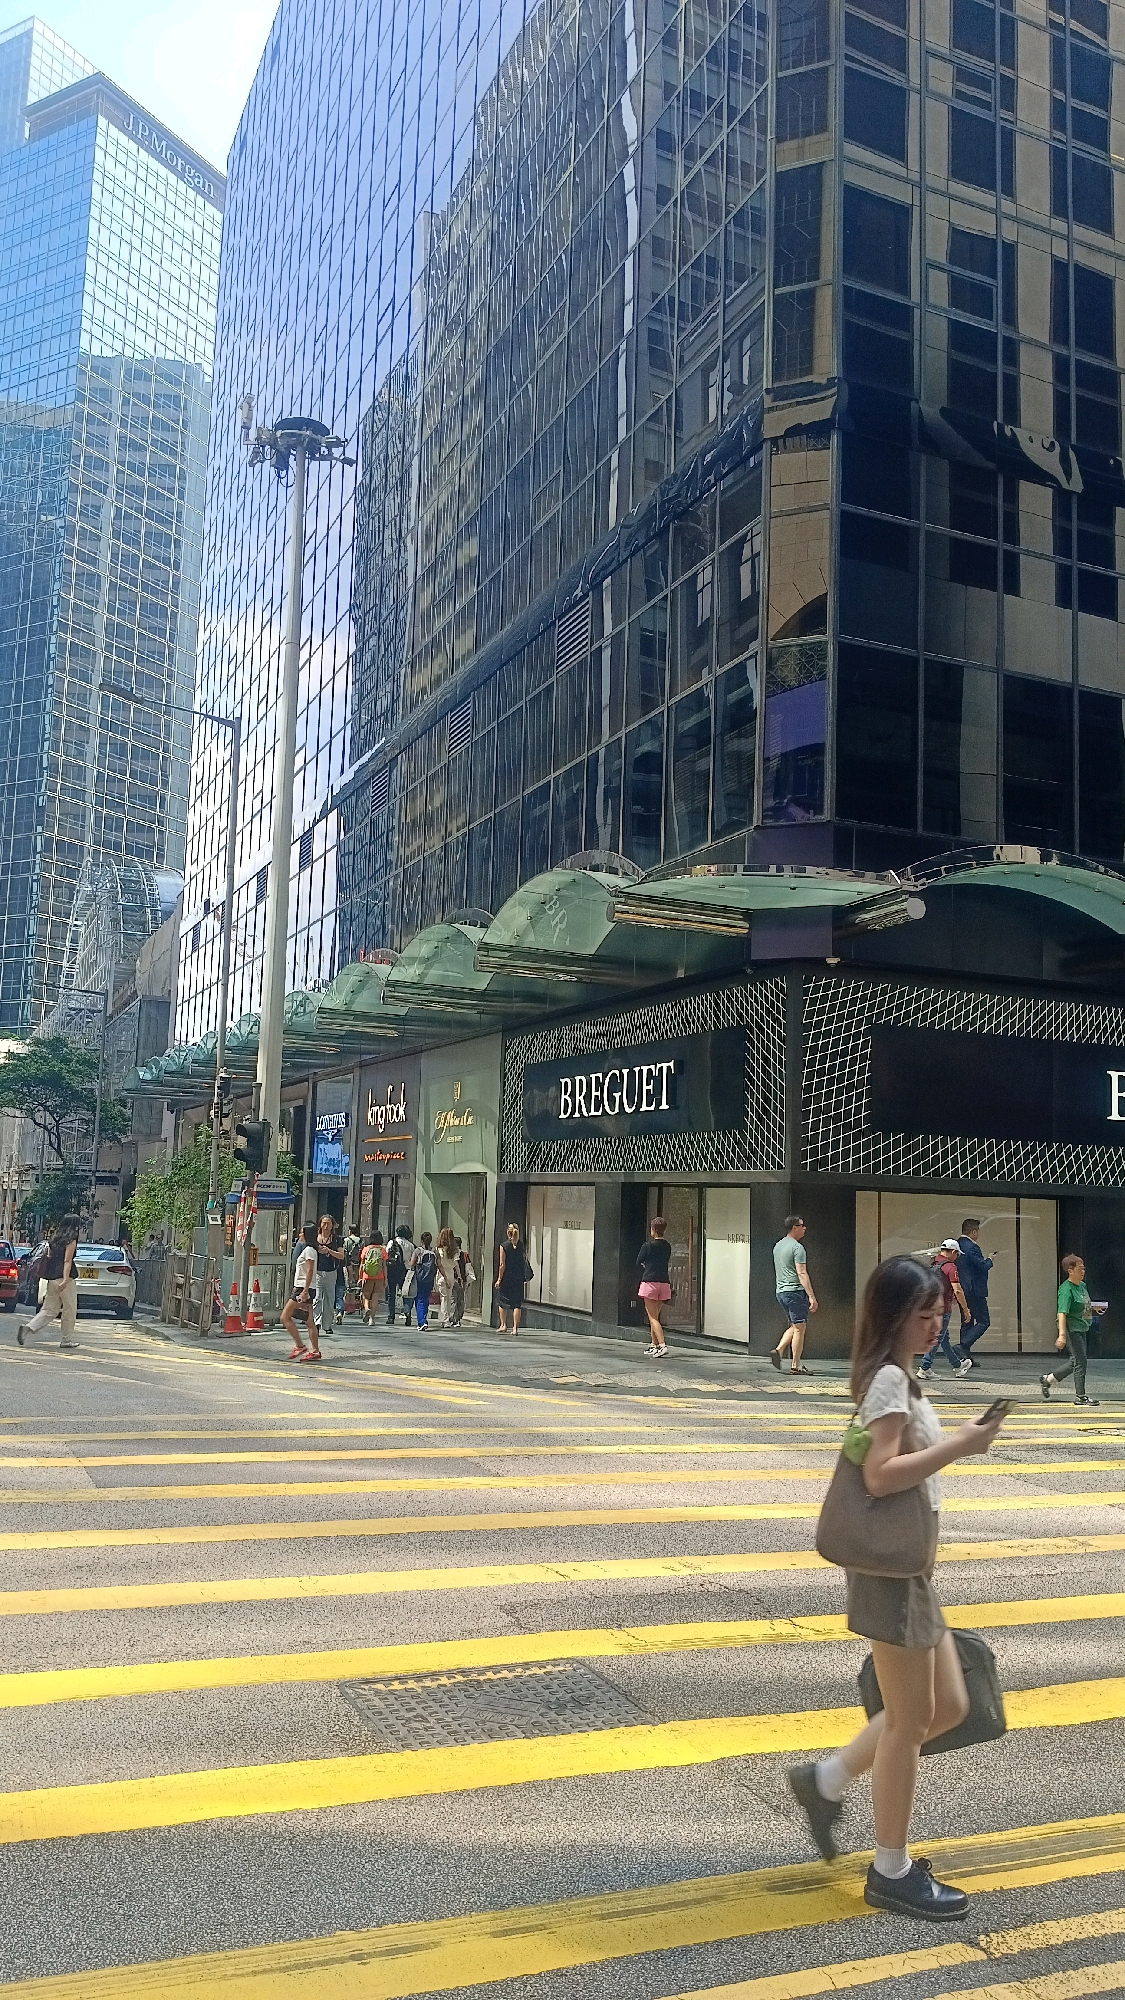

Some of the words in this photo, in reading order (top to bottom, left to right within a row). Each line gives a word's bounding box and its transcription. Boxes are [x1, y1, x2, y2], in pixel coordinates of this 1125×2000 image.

[367, 1088, 386, 1133] king
[386, 1082, 407, 1124] fook
[558, 1059, 675, 1119] BREGUET
